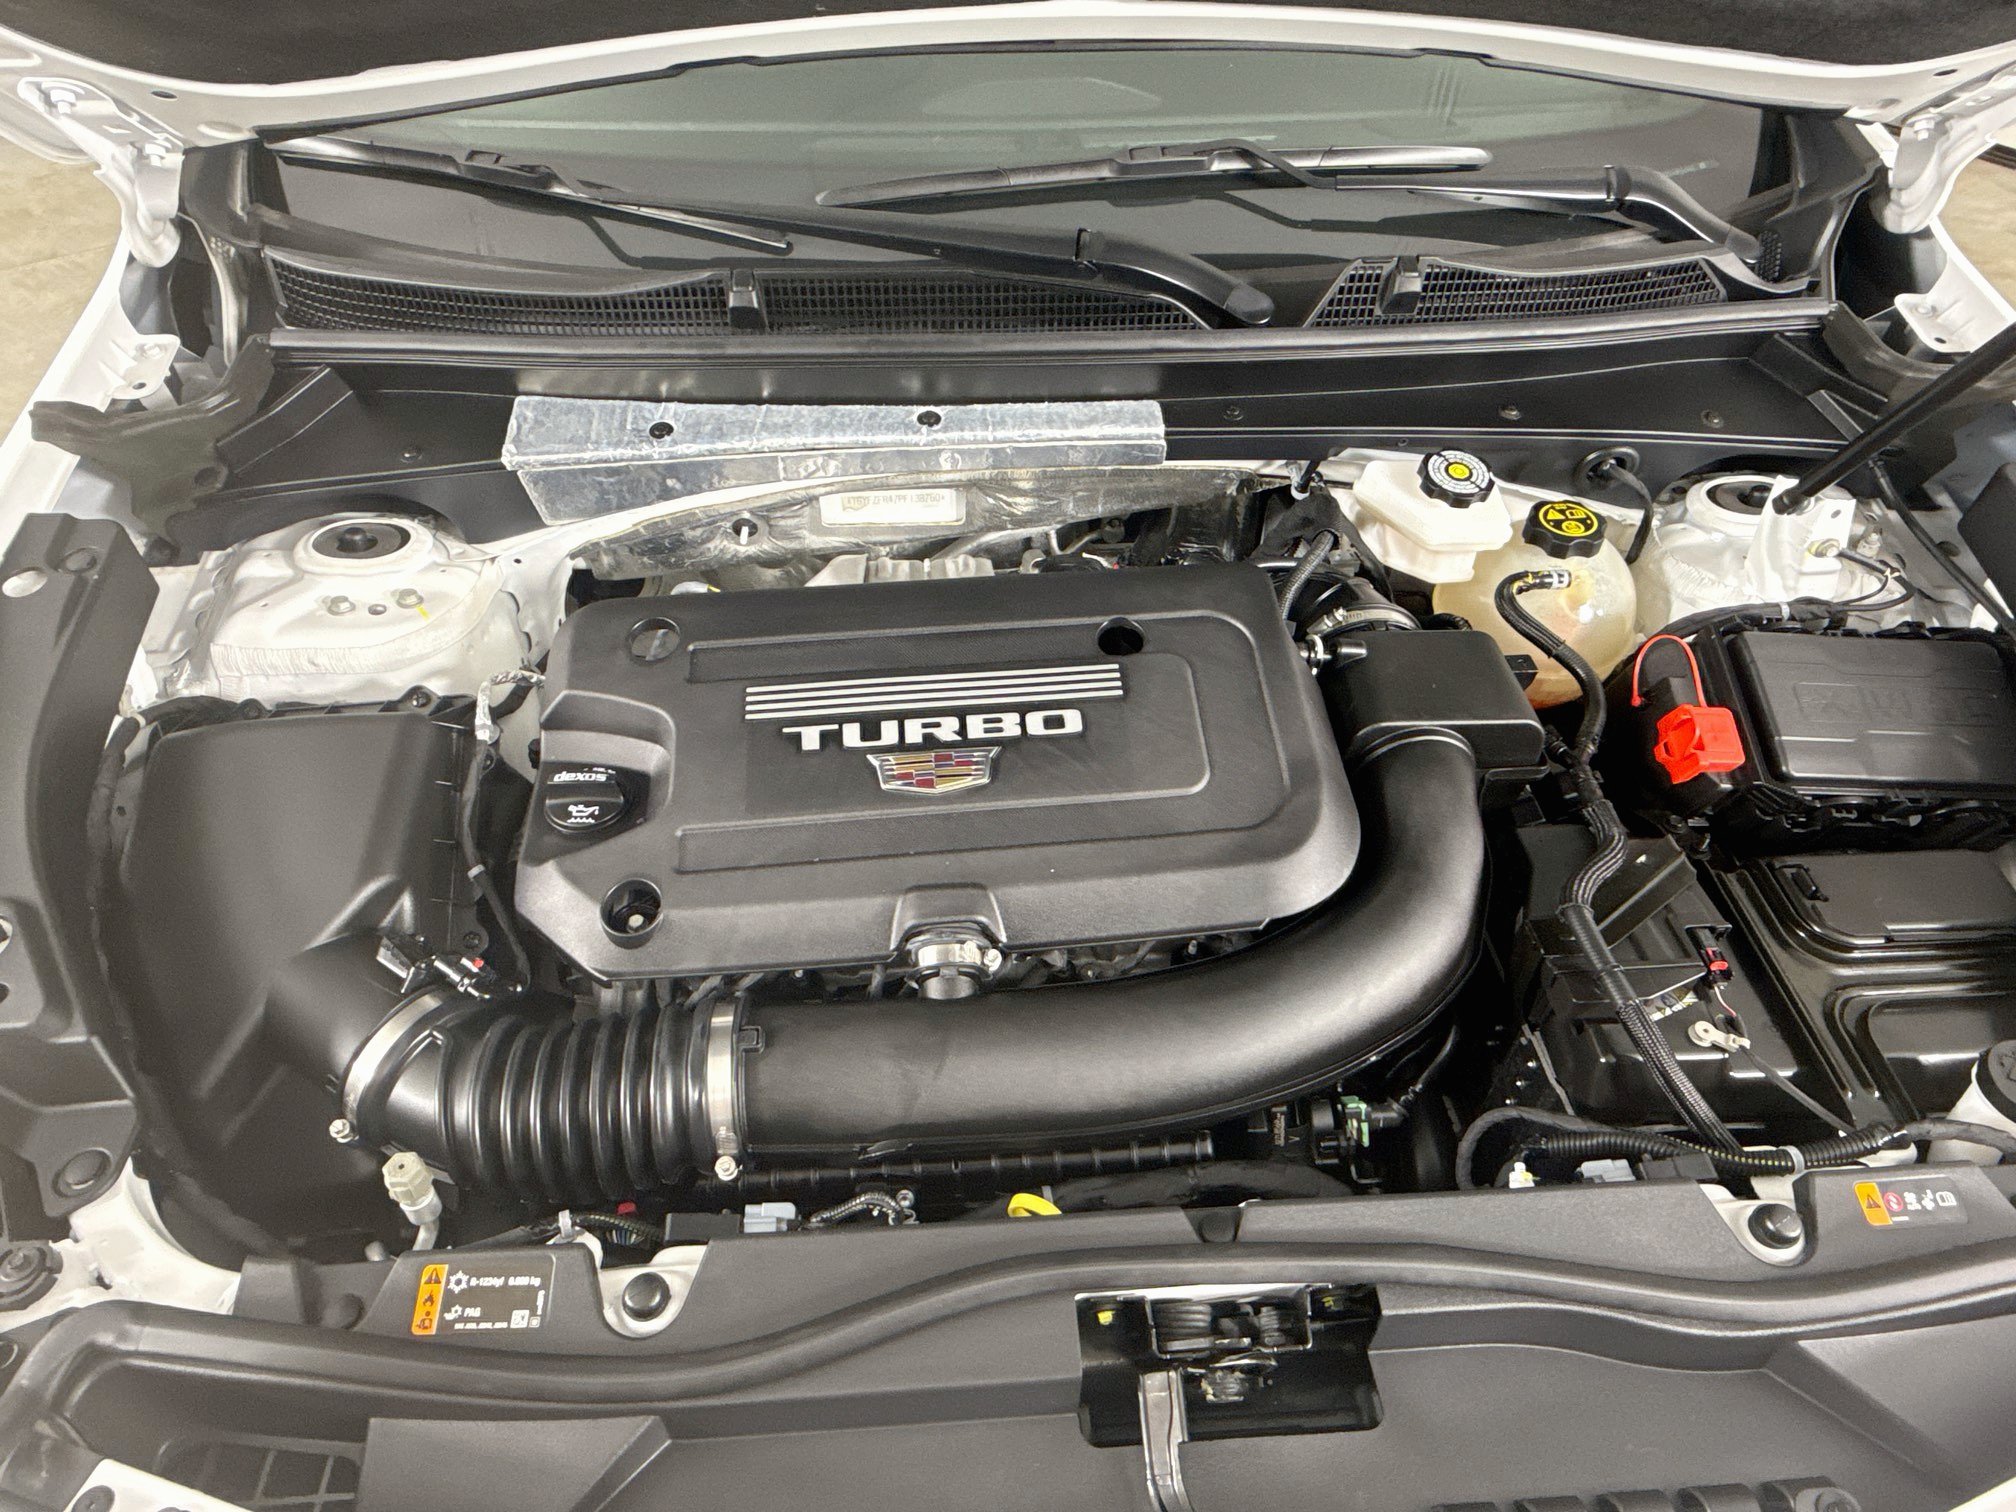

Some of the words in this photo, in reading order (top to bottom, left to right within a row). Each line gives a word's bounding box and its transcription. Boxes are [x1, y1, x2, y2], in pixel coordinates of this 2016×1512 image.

[781, 708, 1083, 752] TURBO
[553, 771, 607, 782] dexos
[464, 1307, 481, 1318] PAG
